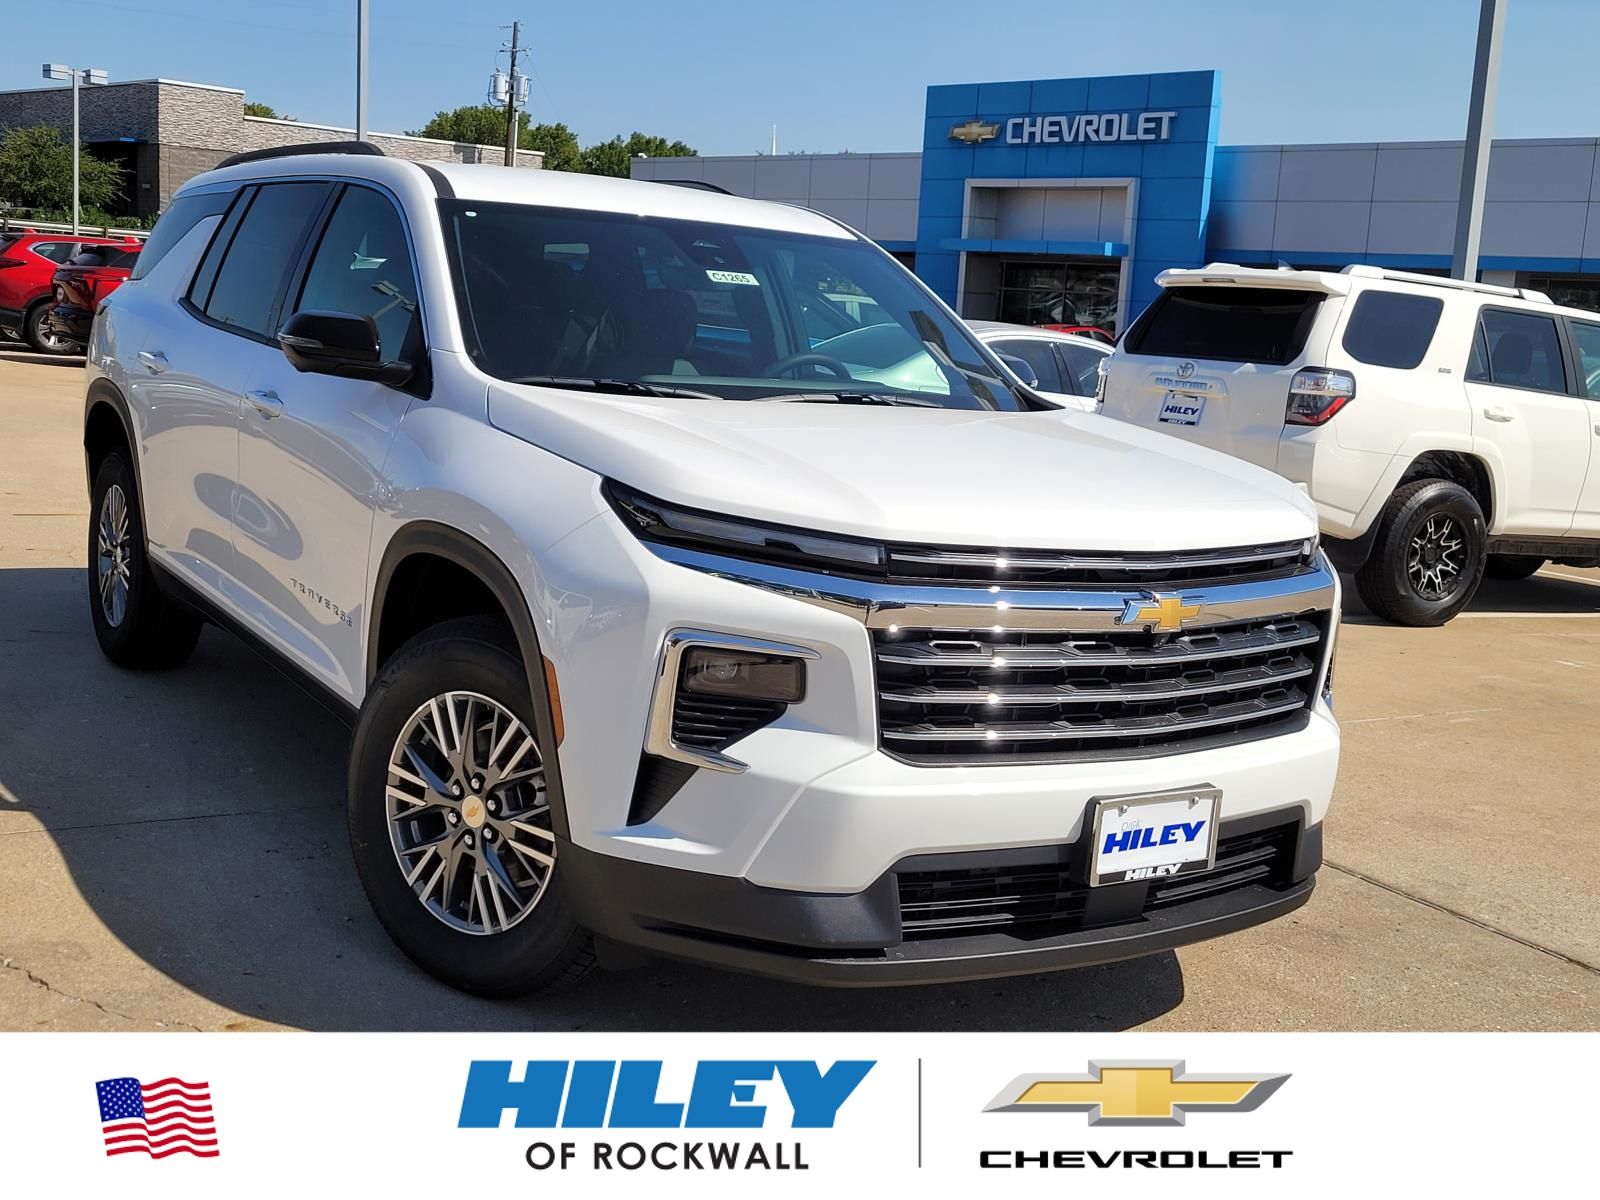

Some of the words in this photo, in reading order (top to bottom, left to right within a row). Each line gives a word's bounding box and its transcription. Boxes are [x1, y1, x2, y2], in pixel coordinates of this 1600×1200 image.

[1005, 111, 1178, 145] CHEVROLET
[712, 272, 750, 283] C1265
[1164, 405, 1199, 415] HILEY
[1102, 820, 1206, 854] HILEY
[1124, 863, 1182, 881] HILEY
